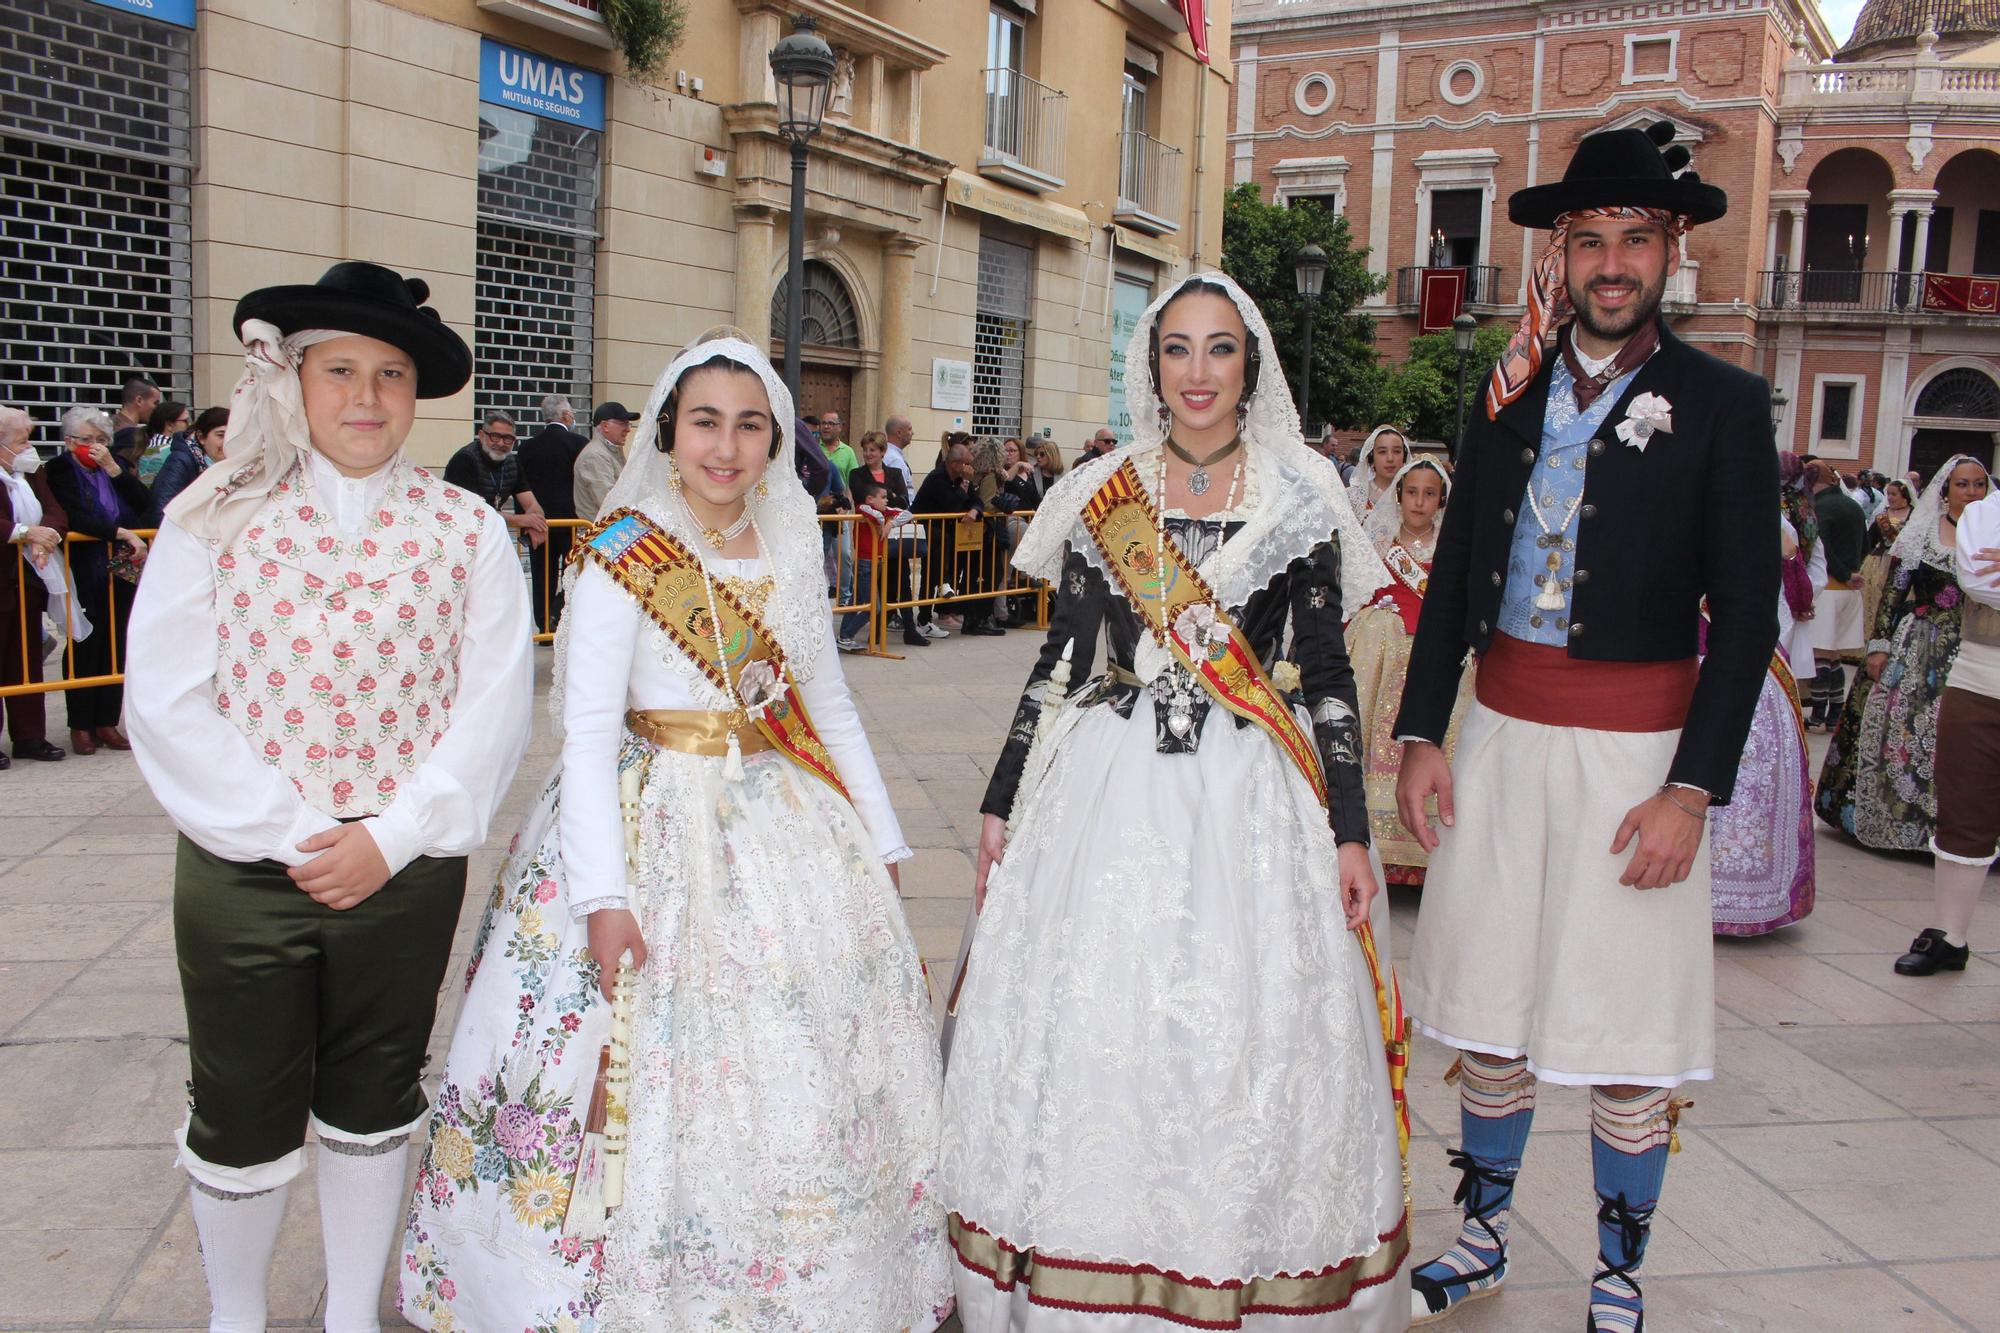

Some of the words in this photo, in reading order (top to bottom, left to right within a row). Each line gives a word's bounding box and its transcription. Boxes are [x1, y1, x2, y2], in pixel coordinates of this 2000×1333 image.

[499, 50, 584, 105] UMAS
[502, 88, 532, 106] MUTUA
[533, 97, 545, 110] DE
[544, 100, 581, 119] SEGUROS
[1104, 509, 1141, 542] 2022
[658, 572, 699, 610] 2022
